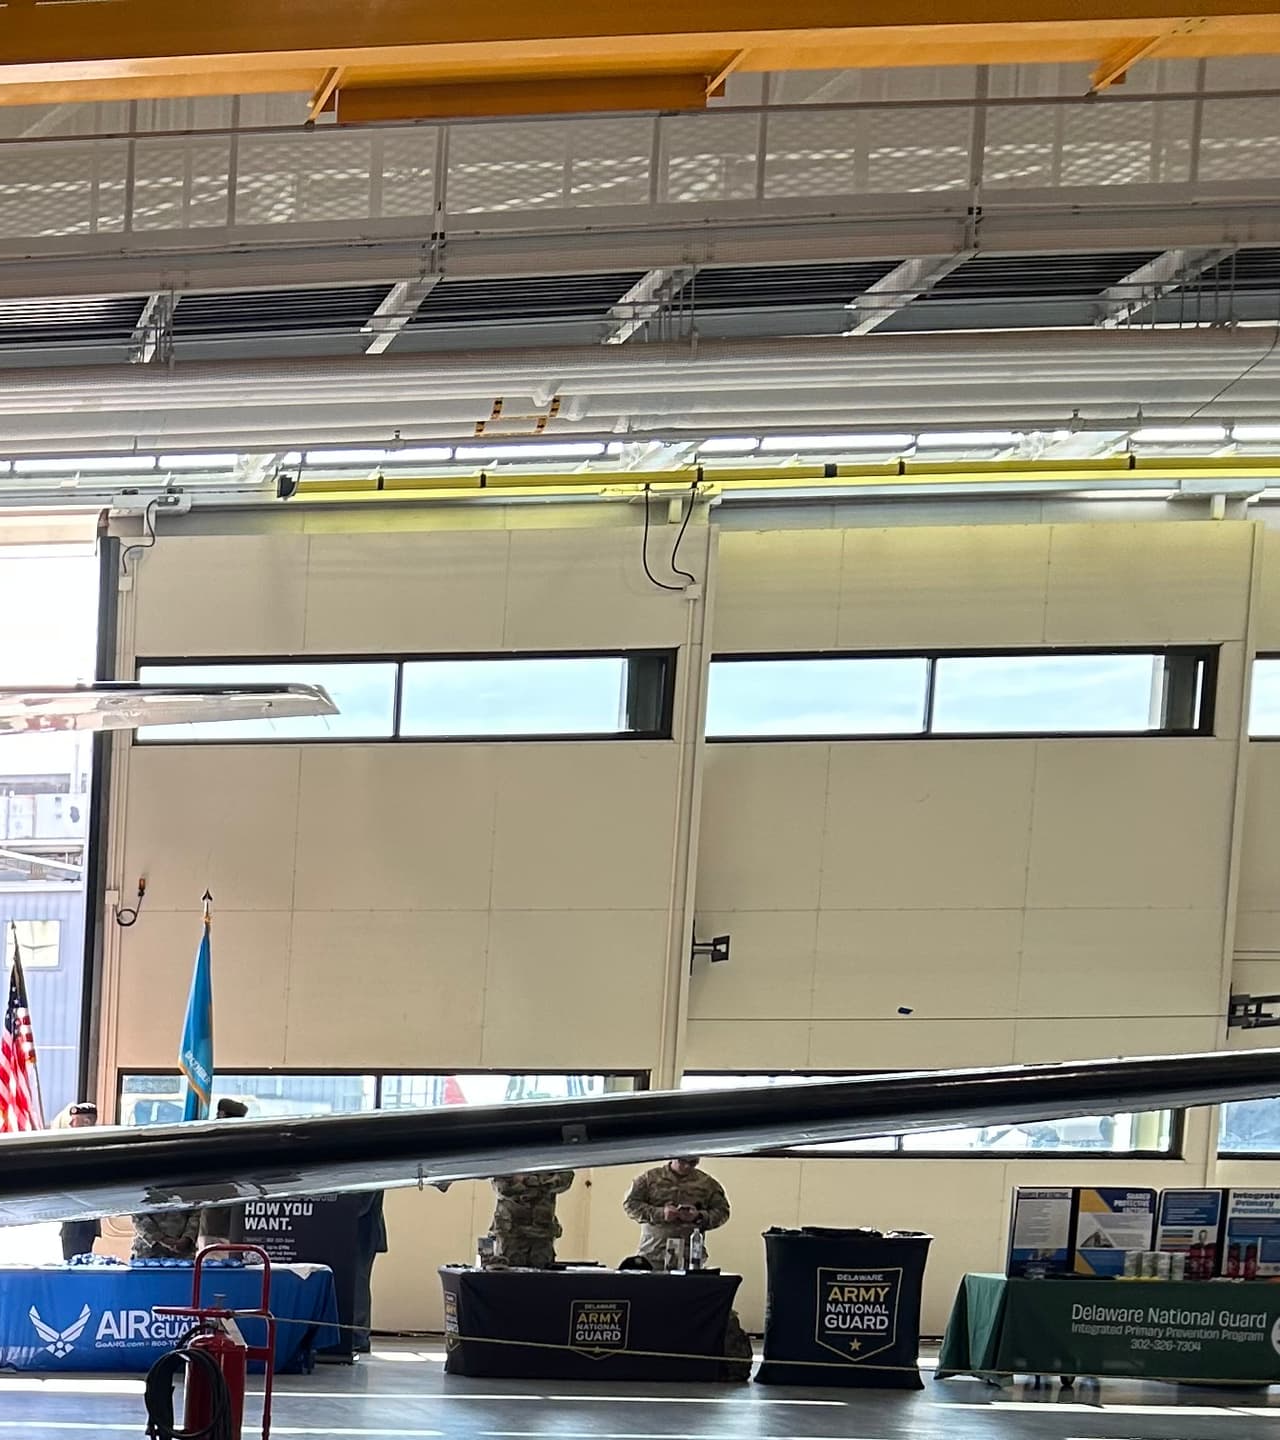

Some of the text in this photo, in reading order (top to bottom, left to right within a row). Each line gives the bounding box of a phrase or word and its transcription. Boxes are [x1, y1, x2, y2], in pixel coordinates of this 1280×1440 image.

[244, 1202, 314, 1216] HOW YOU
[244, 1217, 293, 1231] WANT.
[828, 1286, 890, 1302] ARMY
[826, 1303, 889, 1314] NATIONAL
[577, 1312, 622, 1323] ARMY
[824, 1314, 889, 1330] GUARD
[1072, 1304, 1267, 1328] Delaware National Guard
[96, 1310, 151, 1340] AIR
[576, 1323, 621, 1331] NATIONAL
[1072, 1322, 1123, 1335] Integrated
[575, 1331, 621, 1342] GUARD
